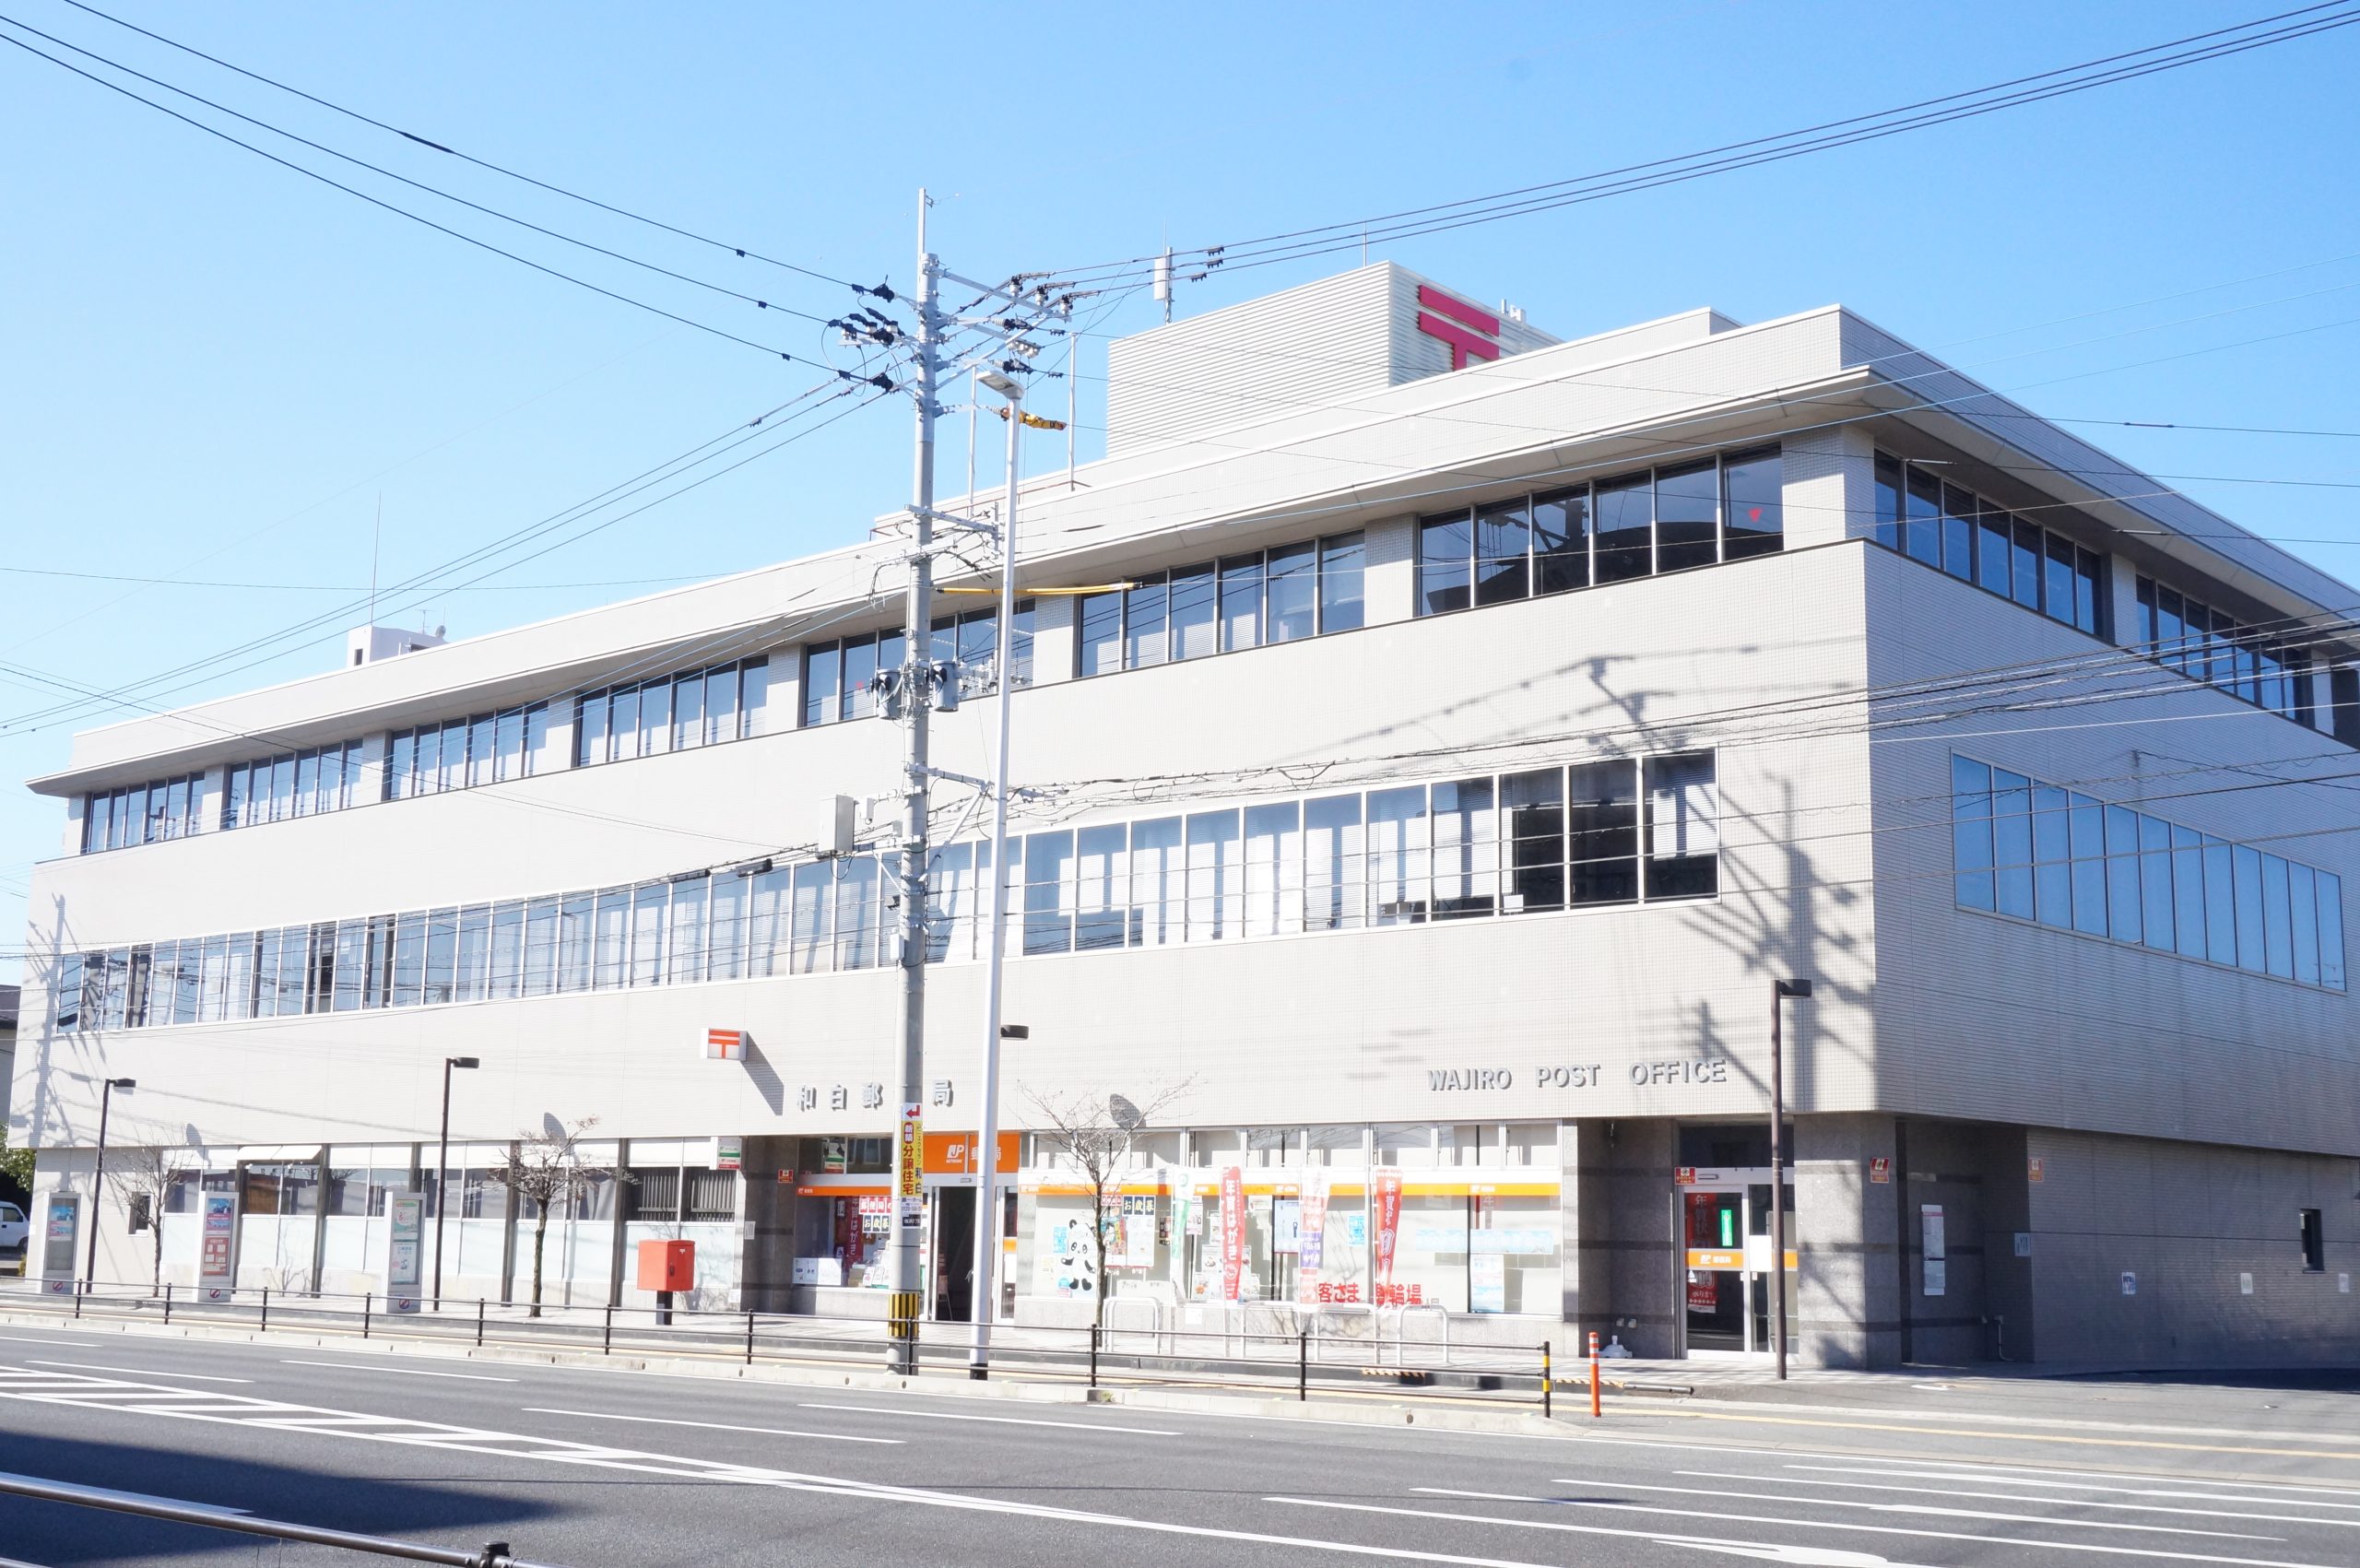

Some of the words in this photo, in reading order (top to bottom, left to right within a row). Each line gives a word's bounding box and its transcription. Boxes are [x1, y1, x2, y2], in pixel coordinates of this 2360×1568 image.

[1428, 1067, 1512, 1091] WAJIRO
[1535, 1063, 1600, 1088] POST
[1629, 1058, 1728, 1085] OFFICE
[797, 1079, 954, 1112] 和白郵局
[903, 1145, 914, 1196] 分譲住宅
[915, 1167, 922, 1194] 和白
[1225, 1179, 1239, 1261] 年賀はがき
